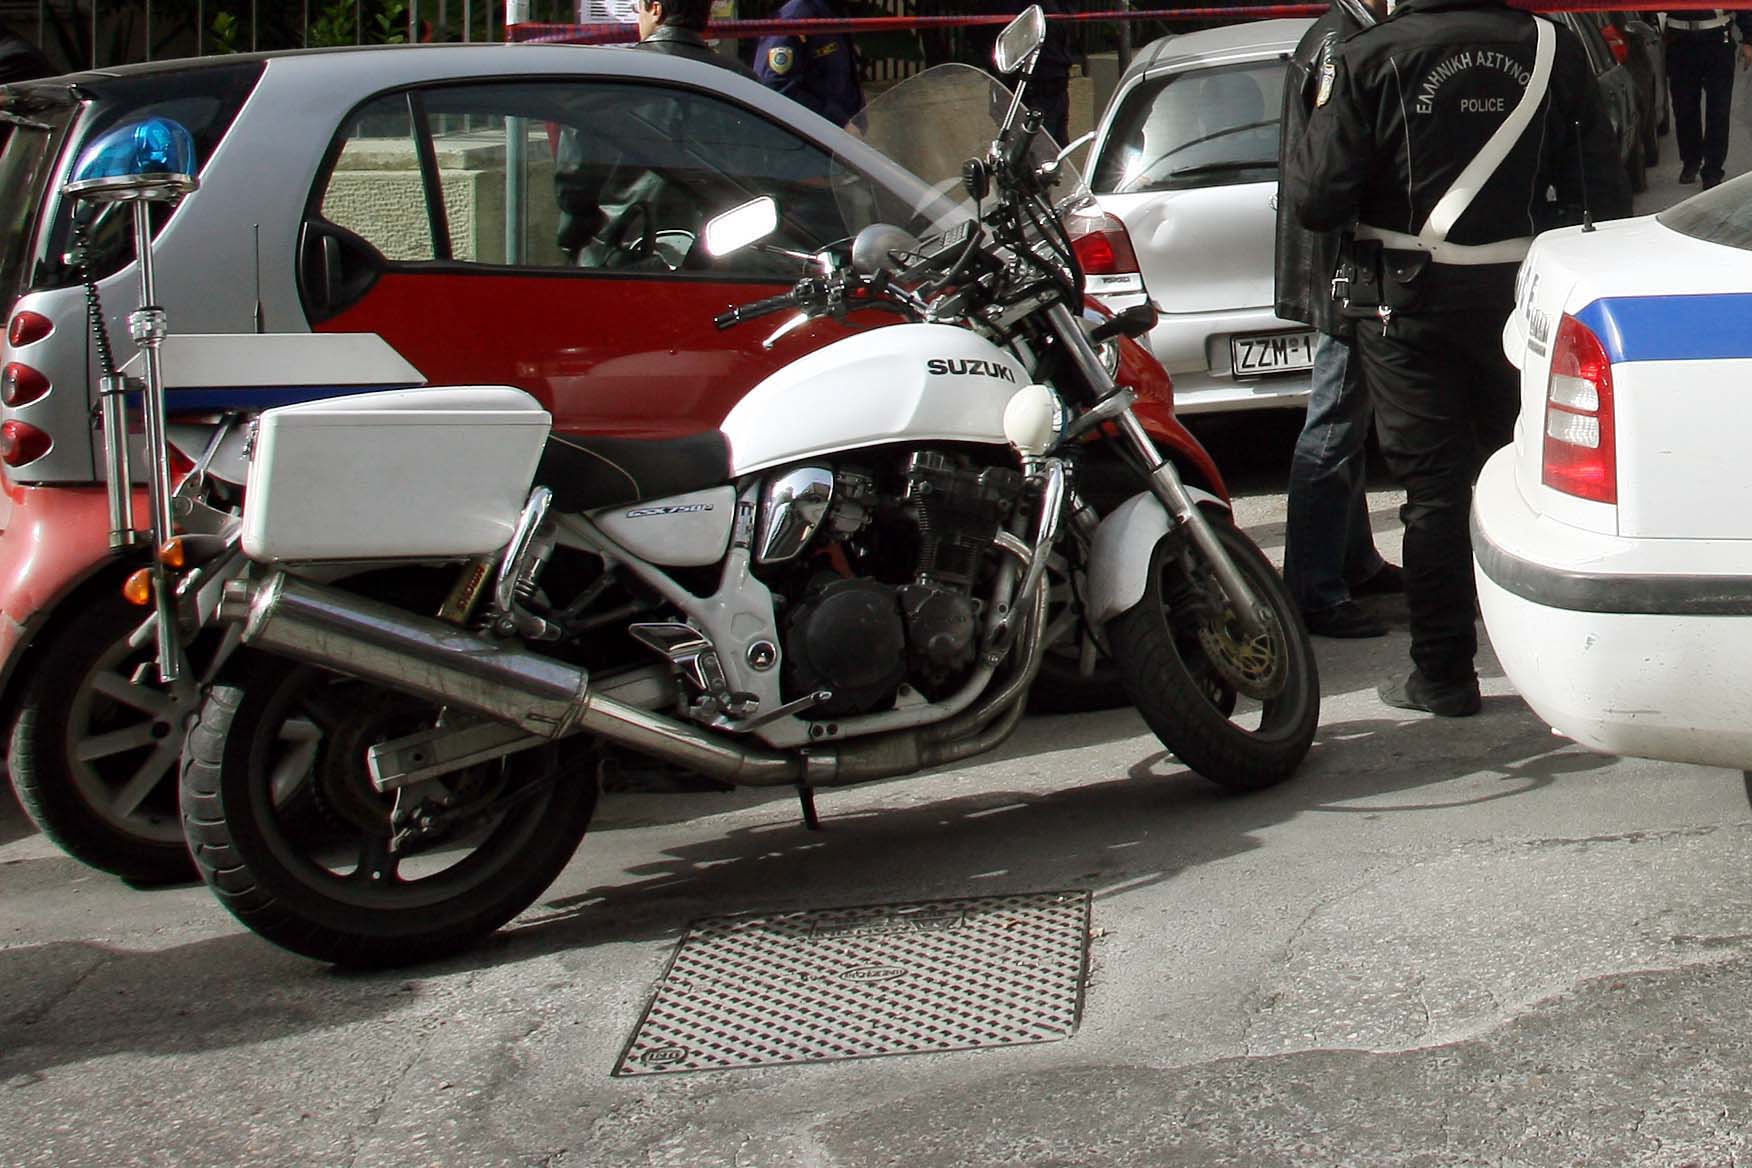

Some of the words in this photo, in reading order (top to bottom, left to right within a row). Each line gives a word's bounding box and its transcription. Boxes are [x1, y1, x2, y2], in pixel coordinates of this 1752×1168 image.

[1416, 51, 1473, 115] ΕΛΛΗΝΙΚΗ
[1475, 50, 1531, 90] ΑΣΤΥΝΟ
[1460, 98, 1505, 113] POLICE
[1240, 336, 1313, 369] ZZM-1
[927, 359, 1016, 384] SUZUKI
